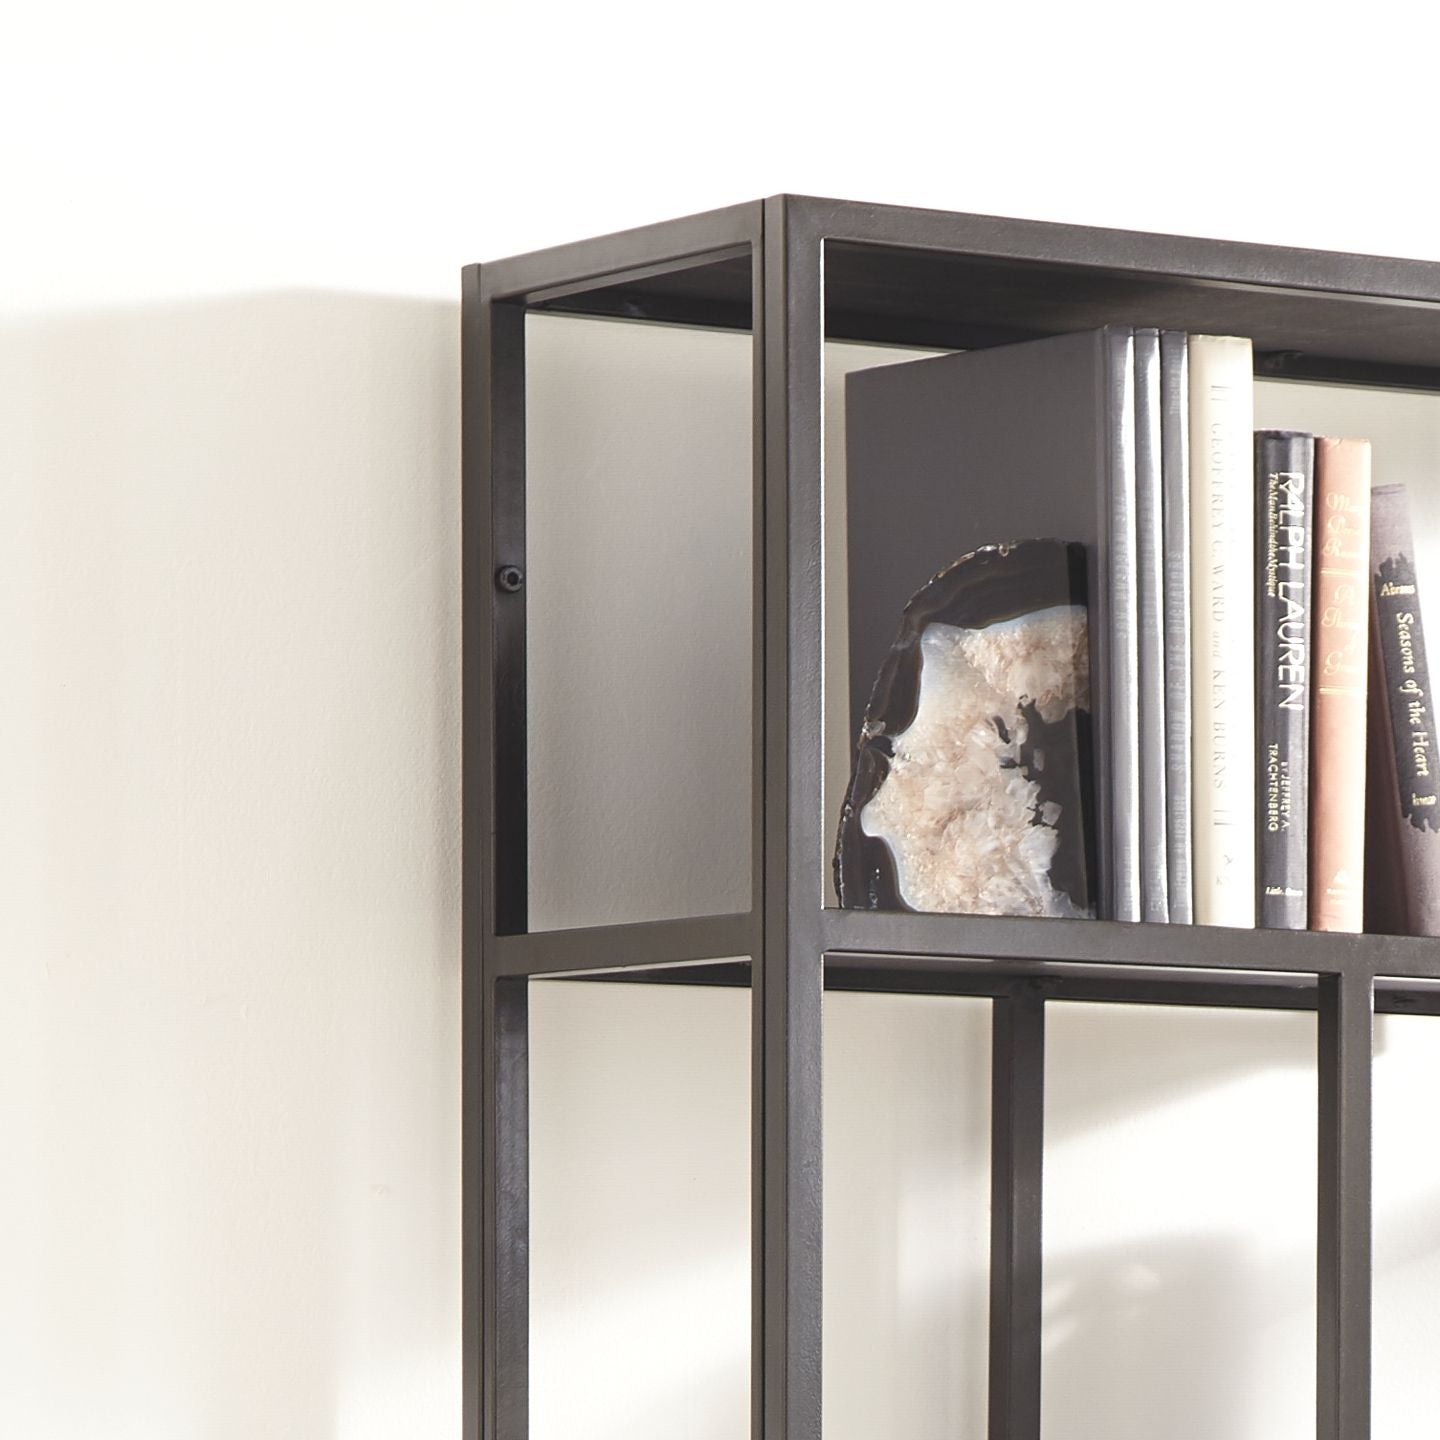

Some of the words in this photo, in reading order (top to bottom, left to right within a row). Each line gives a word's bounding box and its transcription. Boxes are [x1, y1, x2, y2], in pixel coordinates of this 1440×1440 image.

[1211, 423, 1225, 530] GEOFFREY
[1269, 472, 1279, 490] The
[1267, 512, 1279, 543] Behind
[1279, 472, 1305, 569] RALPH
[1212, 540, 1224, 558] C.
[1211, 561, 1225, 622] WARD
[1265, 557, 1278, 598] Mystique
[1212, 631, 1224, 658] and
[1277, 581, 1305, 711] LAUREN
[1396, 612, 1416, 674] Seasons
[1213, 669, 1226, 712] KEN
[1399, 678, 1424, 696] of
[1408, 701, 1427, 724] the
[1213, 721, 1226, 790] BURNS
[1412, 731, 1431, 777] Heart
[1267, 743, 1279, 832] TRACHTENBERG
[1280, 774, 1291, 817] JEFFREY
